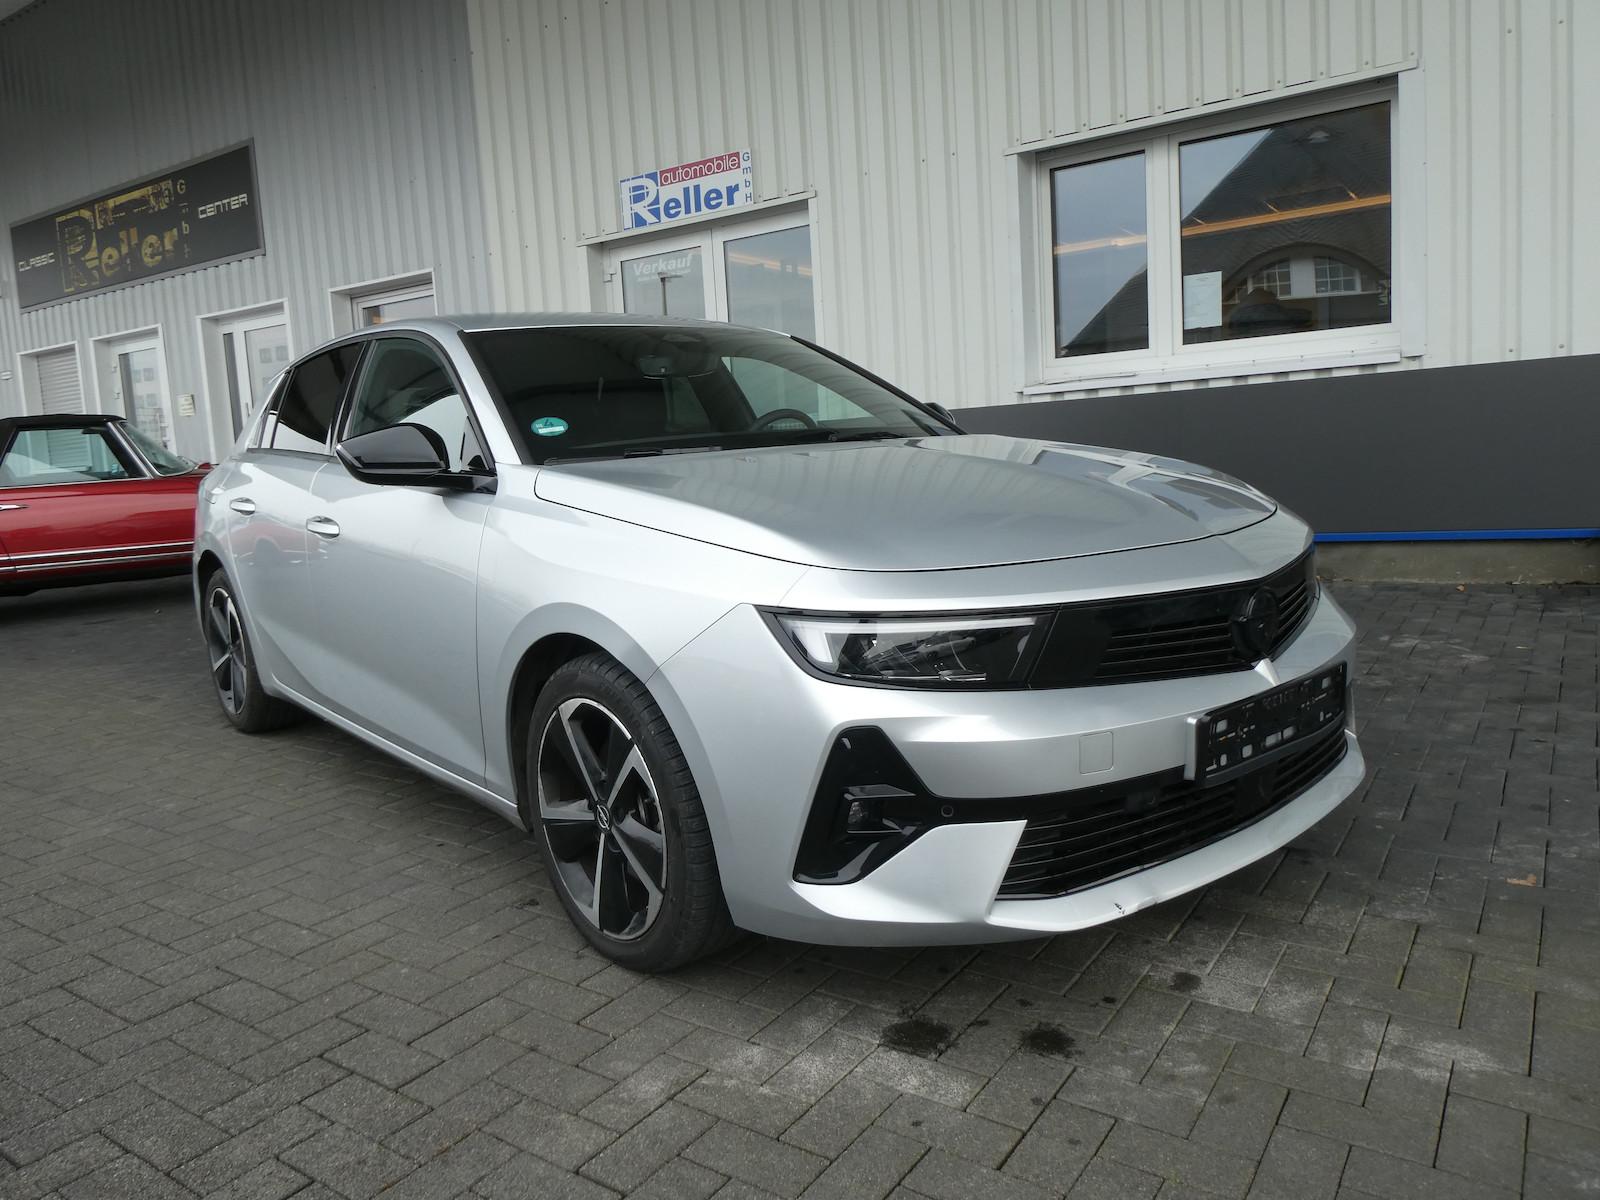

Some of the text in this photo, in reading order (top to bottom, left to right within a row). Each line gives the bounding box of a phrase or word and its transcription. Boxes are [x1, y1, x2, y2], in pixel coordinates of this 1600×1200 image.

[661, 156, 738, 185] automobile
[742, 151, 752, 203] GmbH
[198, 193, 248, 219] CENTER
[620, 177, 740, 229] Reller
[633, 254, 692, 275] Verkauf
